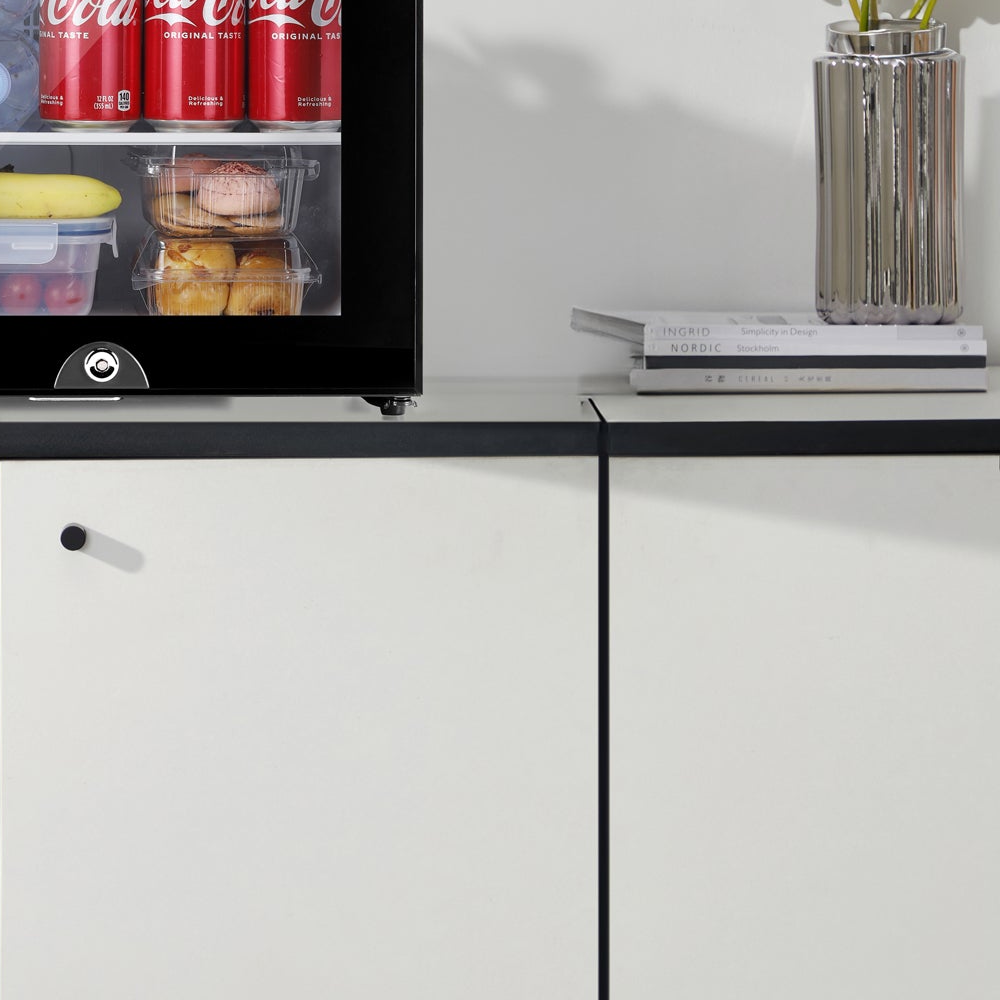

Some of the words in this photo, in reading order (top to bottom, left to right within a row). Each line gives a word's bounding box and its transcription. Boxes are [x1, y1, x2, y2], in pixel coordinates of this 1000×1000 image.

[272, 32, 322, 40] ORIGINAL
[119, 92, 129, 100] 140
[663, 327, 710, 337] INGRID
[741, 327, 779, 336] Simplicity
[780, 328, 789, 336] in
[790, 327, 818, 337] Design
[671, 343, 722, 353] NORDIC
[736, 344, 780, 353] Stockholm
